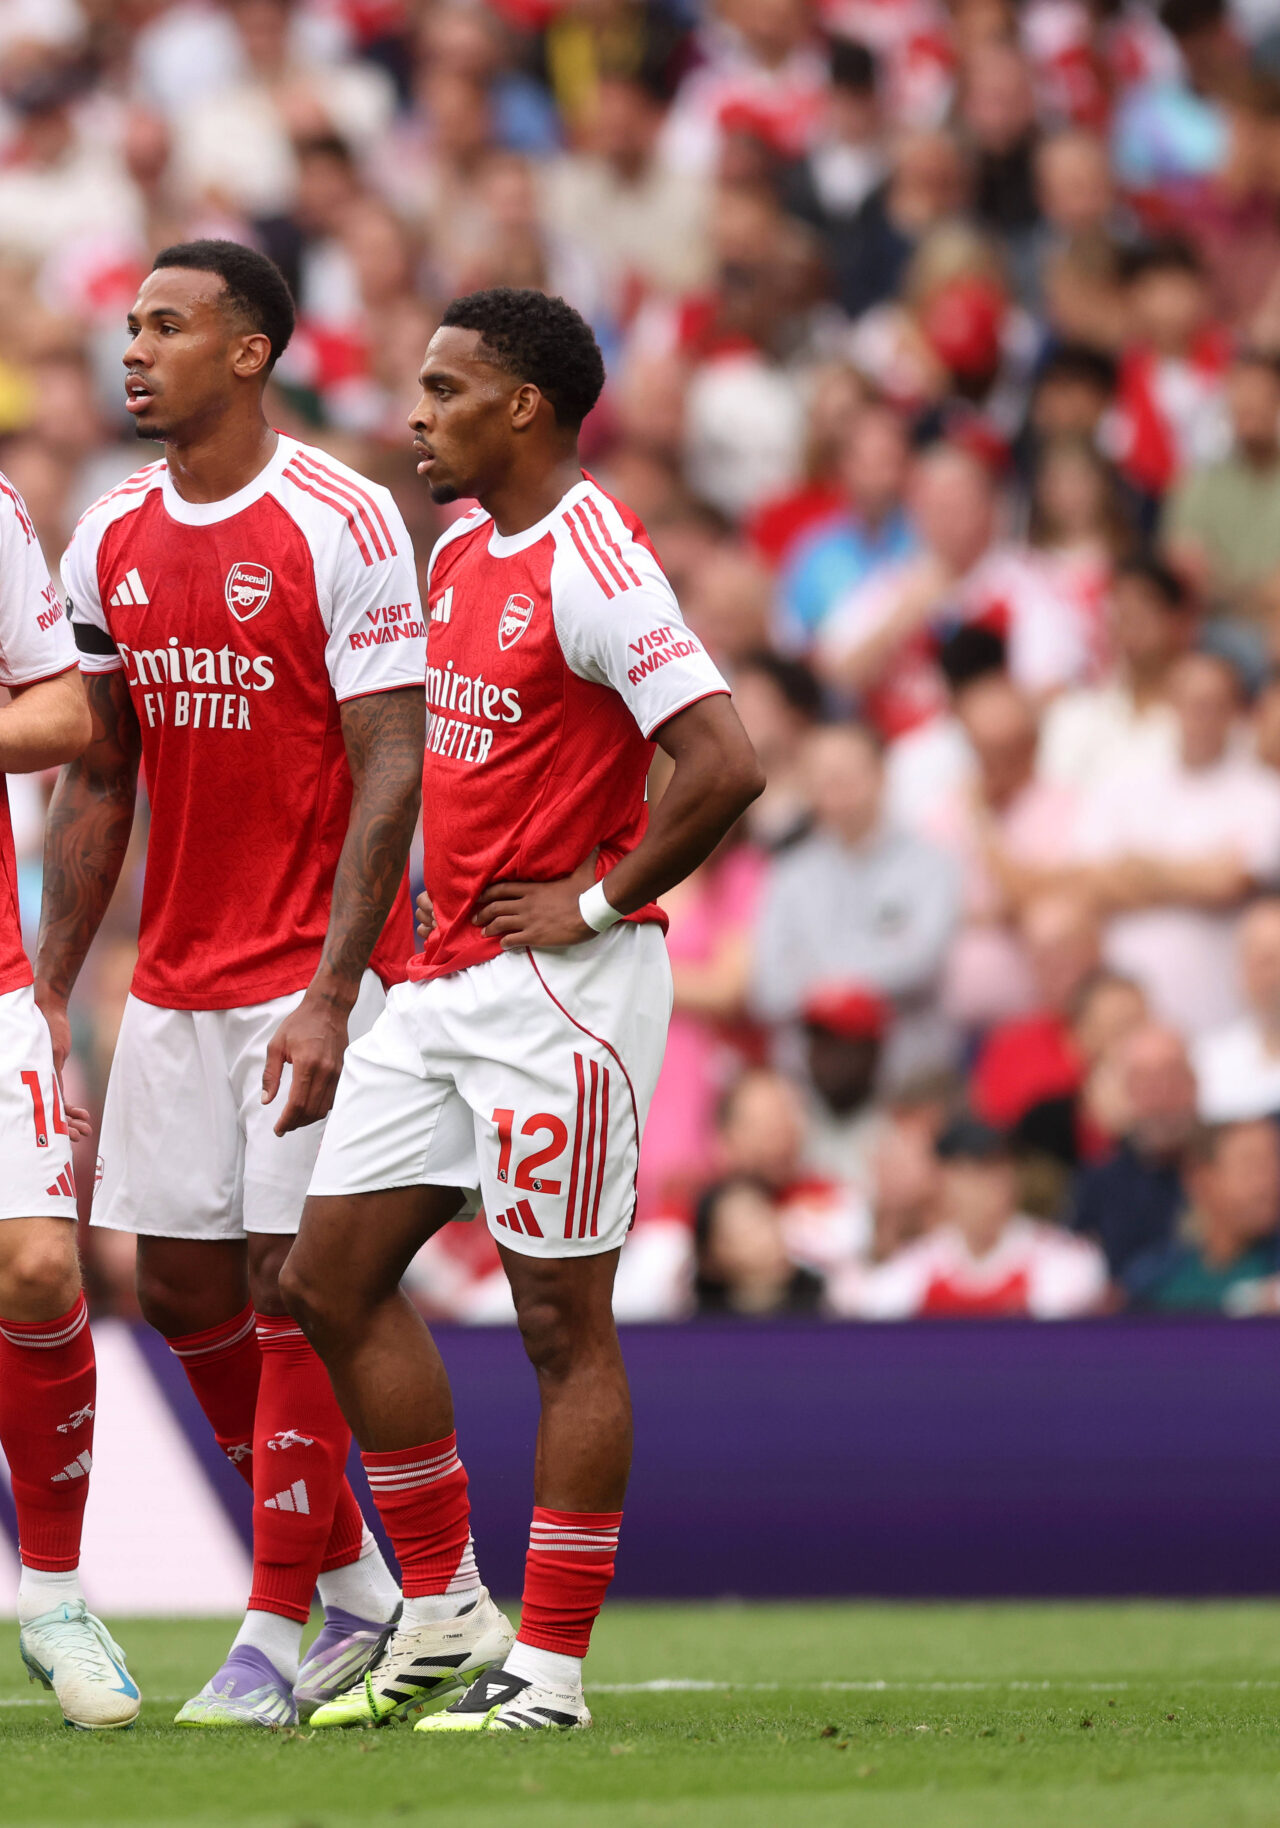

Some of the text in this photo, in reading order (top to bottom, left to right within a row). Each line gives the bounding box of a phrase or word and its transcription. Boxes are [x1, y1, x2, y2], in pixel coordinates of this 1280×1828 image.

[234, 570, 266, 585] Arsenal
[365, 603, 412, 625] VISIT
[348, 621, 428, 651] RWANDA
[628, 626, 675, 655] VISIT
[627, 639, 701, 686] RWANDA
[174, 690, 252, 731] BTTER
[425, 660, 522, 723] mirates
[431, 716, 494, 764] BETTER
[491, 1107, 569, 1196] 12
